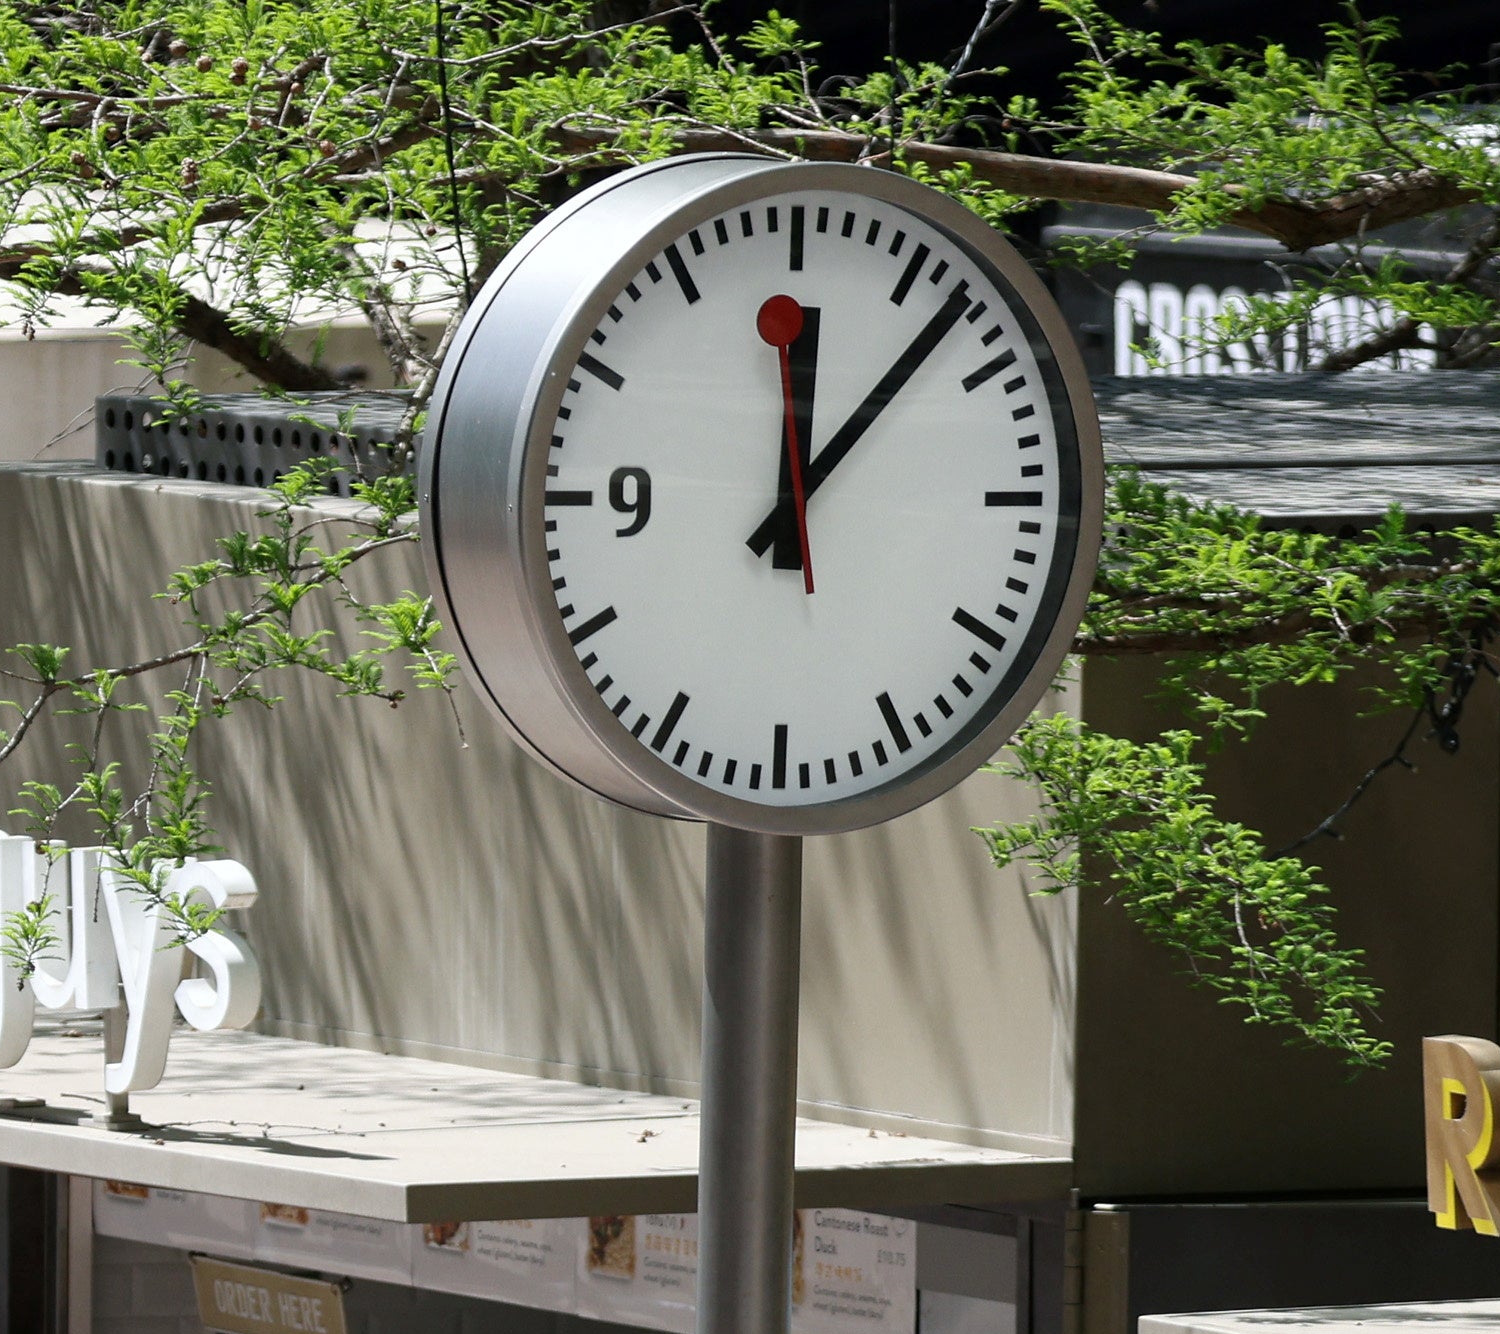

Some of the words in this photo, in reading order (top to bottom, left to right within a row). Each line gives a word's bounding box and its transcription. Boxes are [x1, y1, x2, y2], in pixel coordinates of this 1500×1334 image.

[608, 467, 651, 537] 9
[815, 1236, 838, 1254] Duck
[863, 1217, 889, 1237] Roast
[213, 1279, 273, 1324] ORDER
[278, 1291, 327, 1334] HERE
